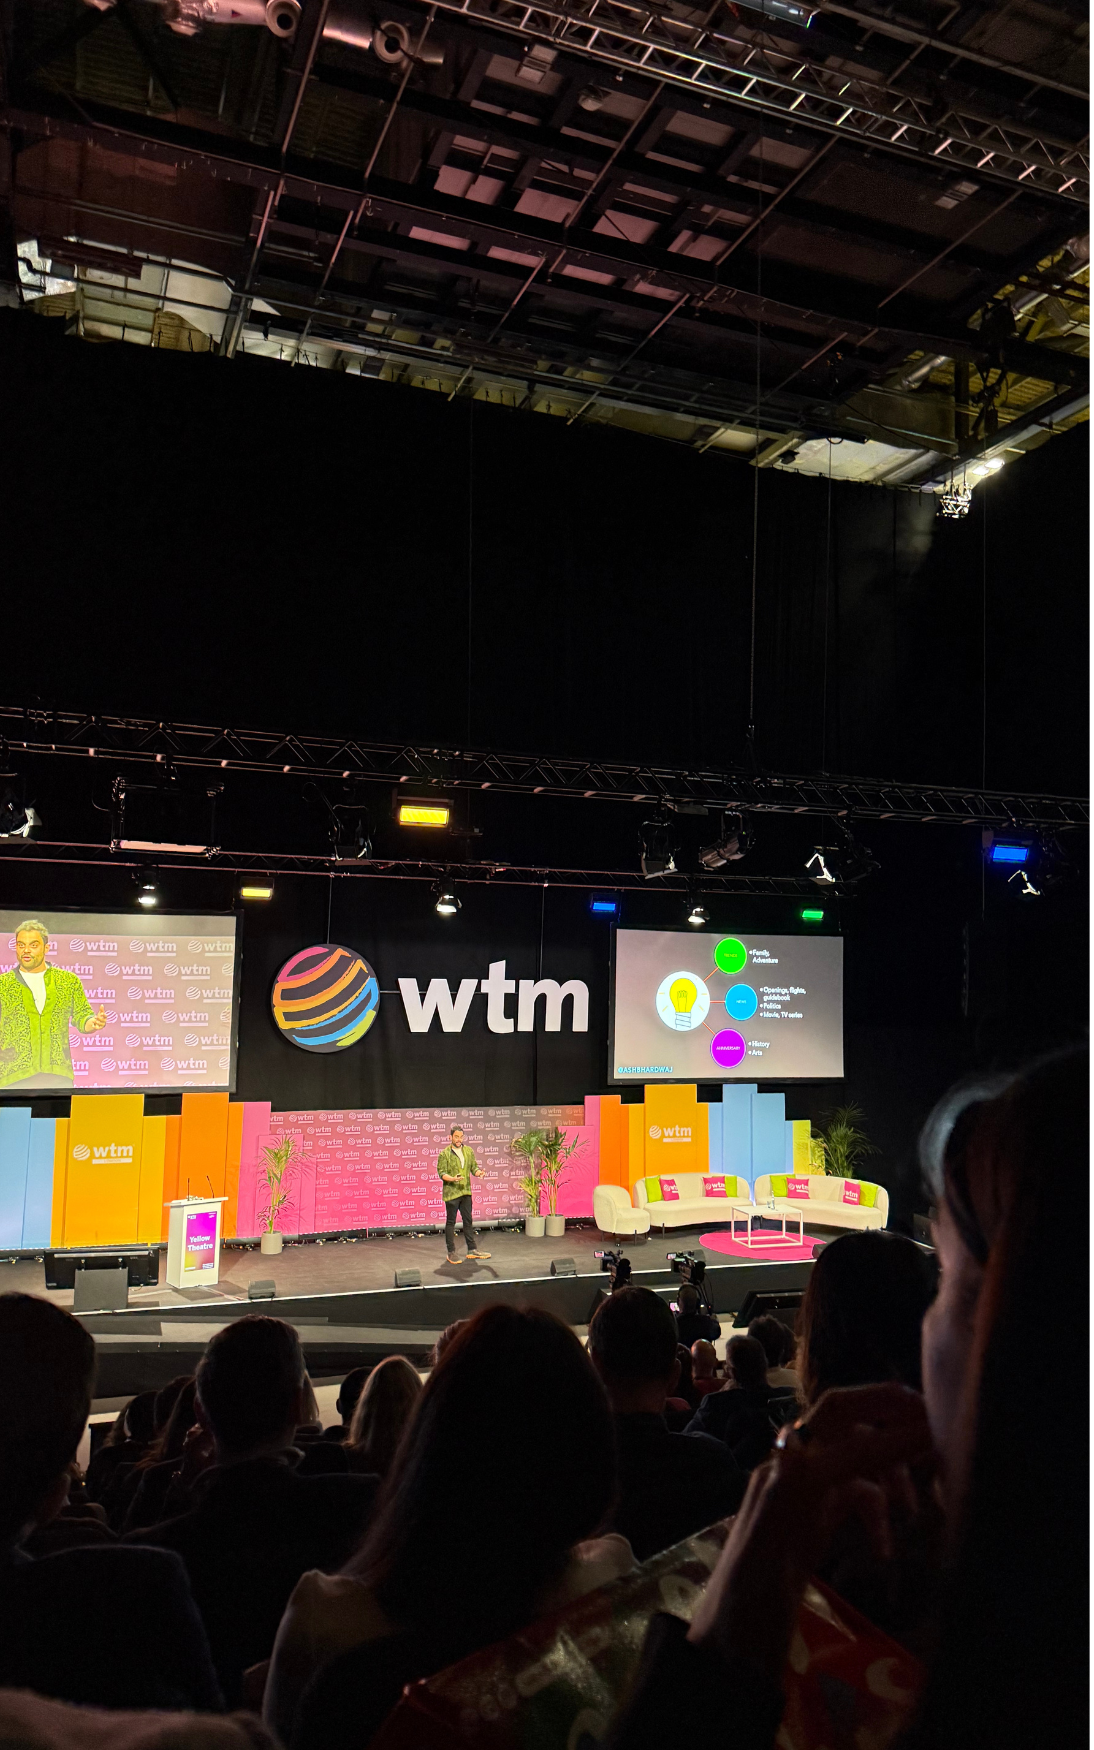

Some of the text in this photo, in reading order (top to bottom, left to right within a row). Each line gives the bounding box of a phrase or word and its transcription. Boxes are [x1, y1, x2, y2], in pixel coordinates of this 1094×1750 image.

[86, 940, 117, 950] wtm
[146, 941, 176, 951] wtm
[205, 941, 234, 951] wtm
[122, 964, 152, 974] wtm
[181, 964, 210, 974] wtm
[144, 987, 174, 998] wtm
[203, 987, 232, 997] wtm
[398, 960, 589, 1033] wtm
[120, 1010, 150, 1021] wtm
[179, 1010, 208, 1021] wtm
[83, 1034, 113, 1045] wtm
[142, 1034, 172, 1045] wtm
[72, 1059, 89, 1070] tm
[118, 1058, 148, 1069] wtm
[177, 1058, 207, 1069] wtm
[663, 1125, 692, 1136] wtm
[93, 1143, 133, 1157] wtm
[188, 1243, 213, 1251] Theatre
